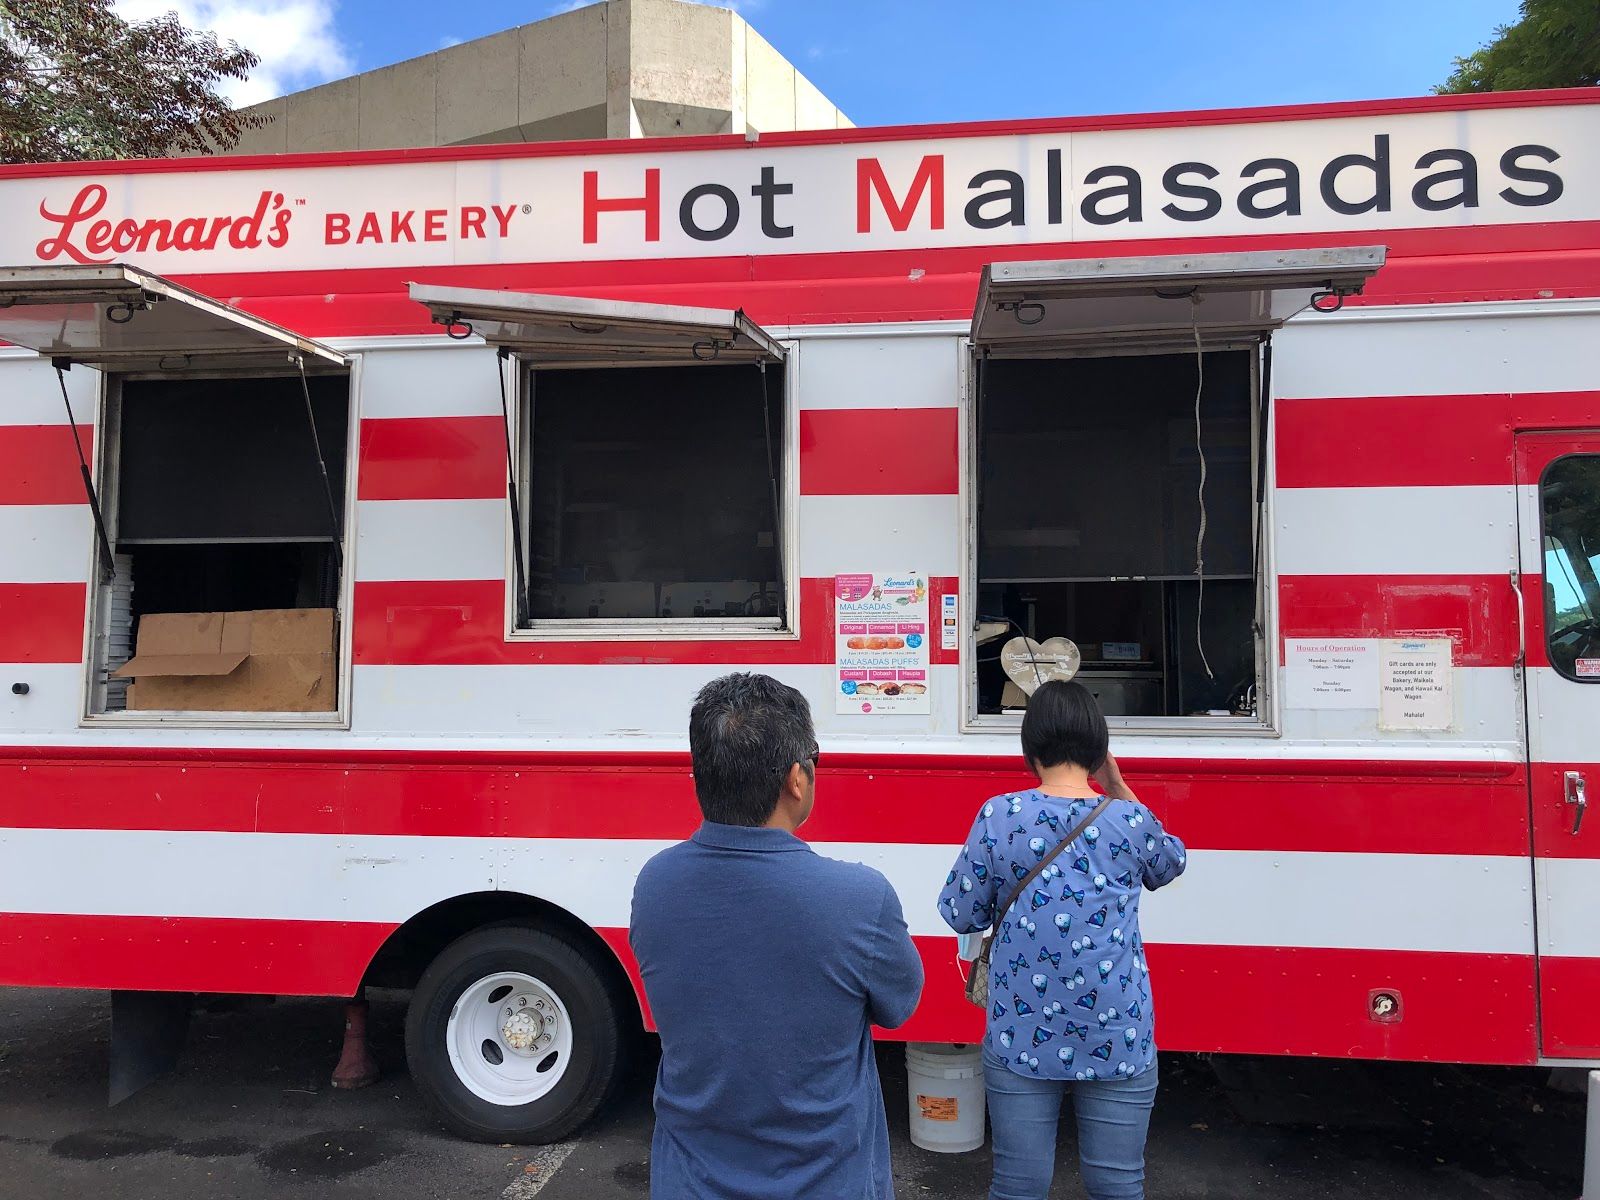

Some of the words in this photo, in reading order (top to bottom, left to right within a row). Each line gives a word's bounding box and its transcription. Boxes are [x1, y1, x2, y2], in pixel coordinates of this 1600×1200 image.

[583, 166, 794, 244] Hot
[856, 133, 1564, 234] Malasadas
[324, 204, 518, 245] BAKERY
[884, 577, 915, 587] Leonard's
